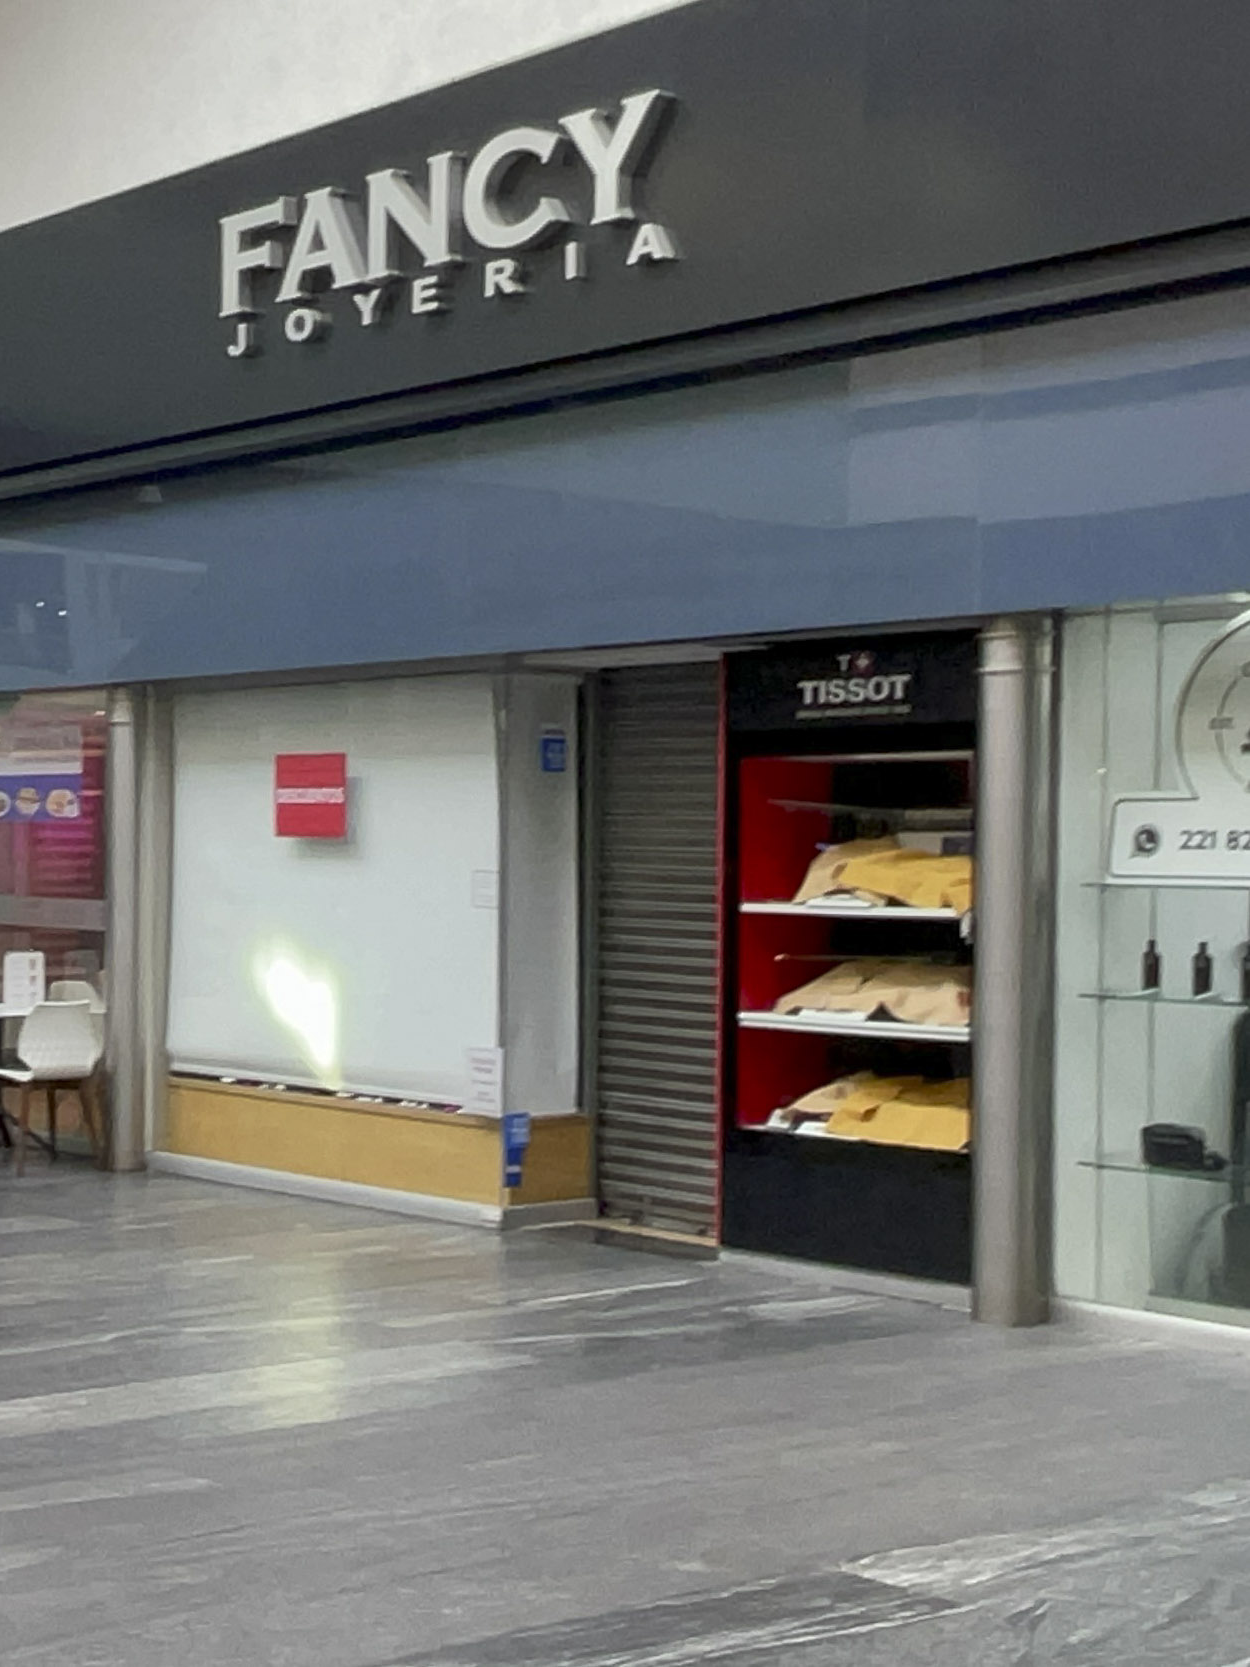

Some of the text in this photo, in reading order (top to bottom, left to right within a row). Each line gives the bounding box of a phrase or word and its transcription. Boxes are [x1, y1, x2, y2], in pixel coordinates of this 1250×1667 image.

[219, 89, 672, 317] FANCY
[227, 223, 676, 357] JOYERIA
[796, 674, 911, 705] TISSOT
[1179, 830, 1216, 850] 221
